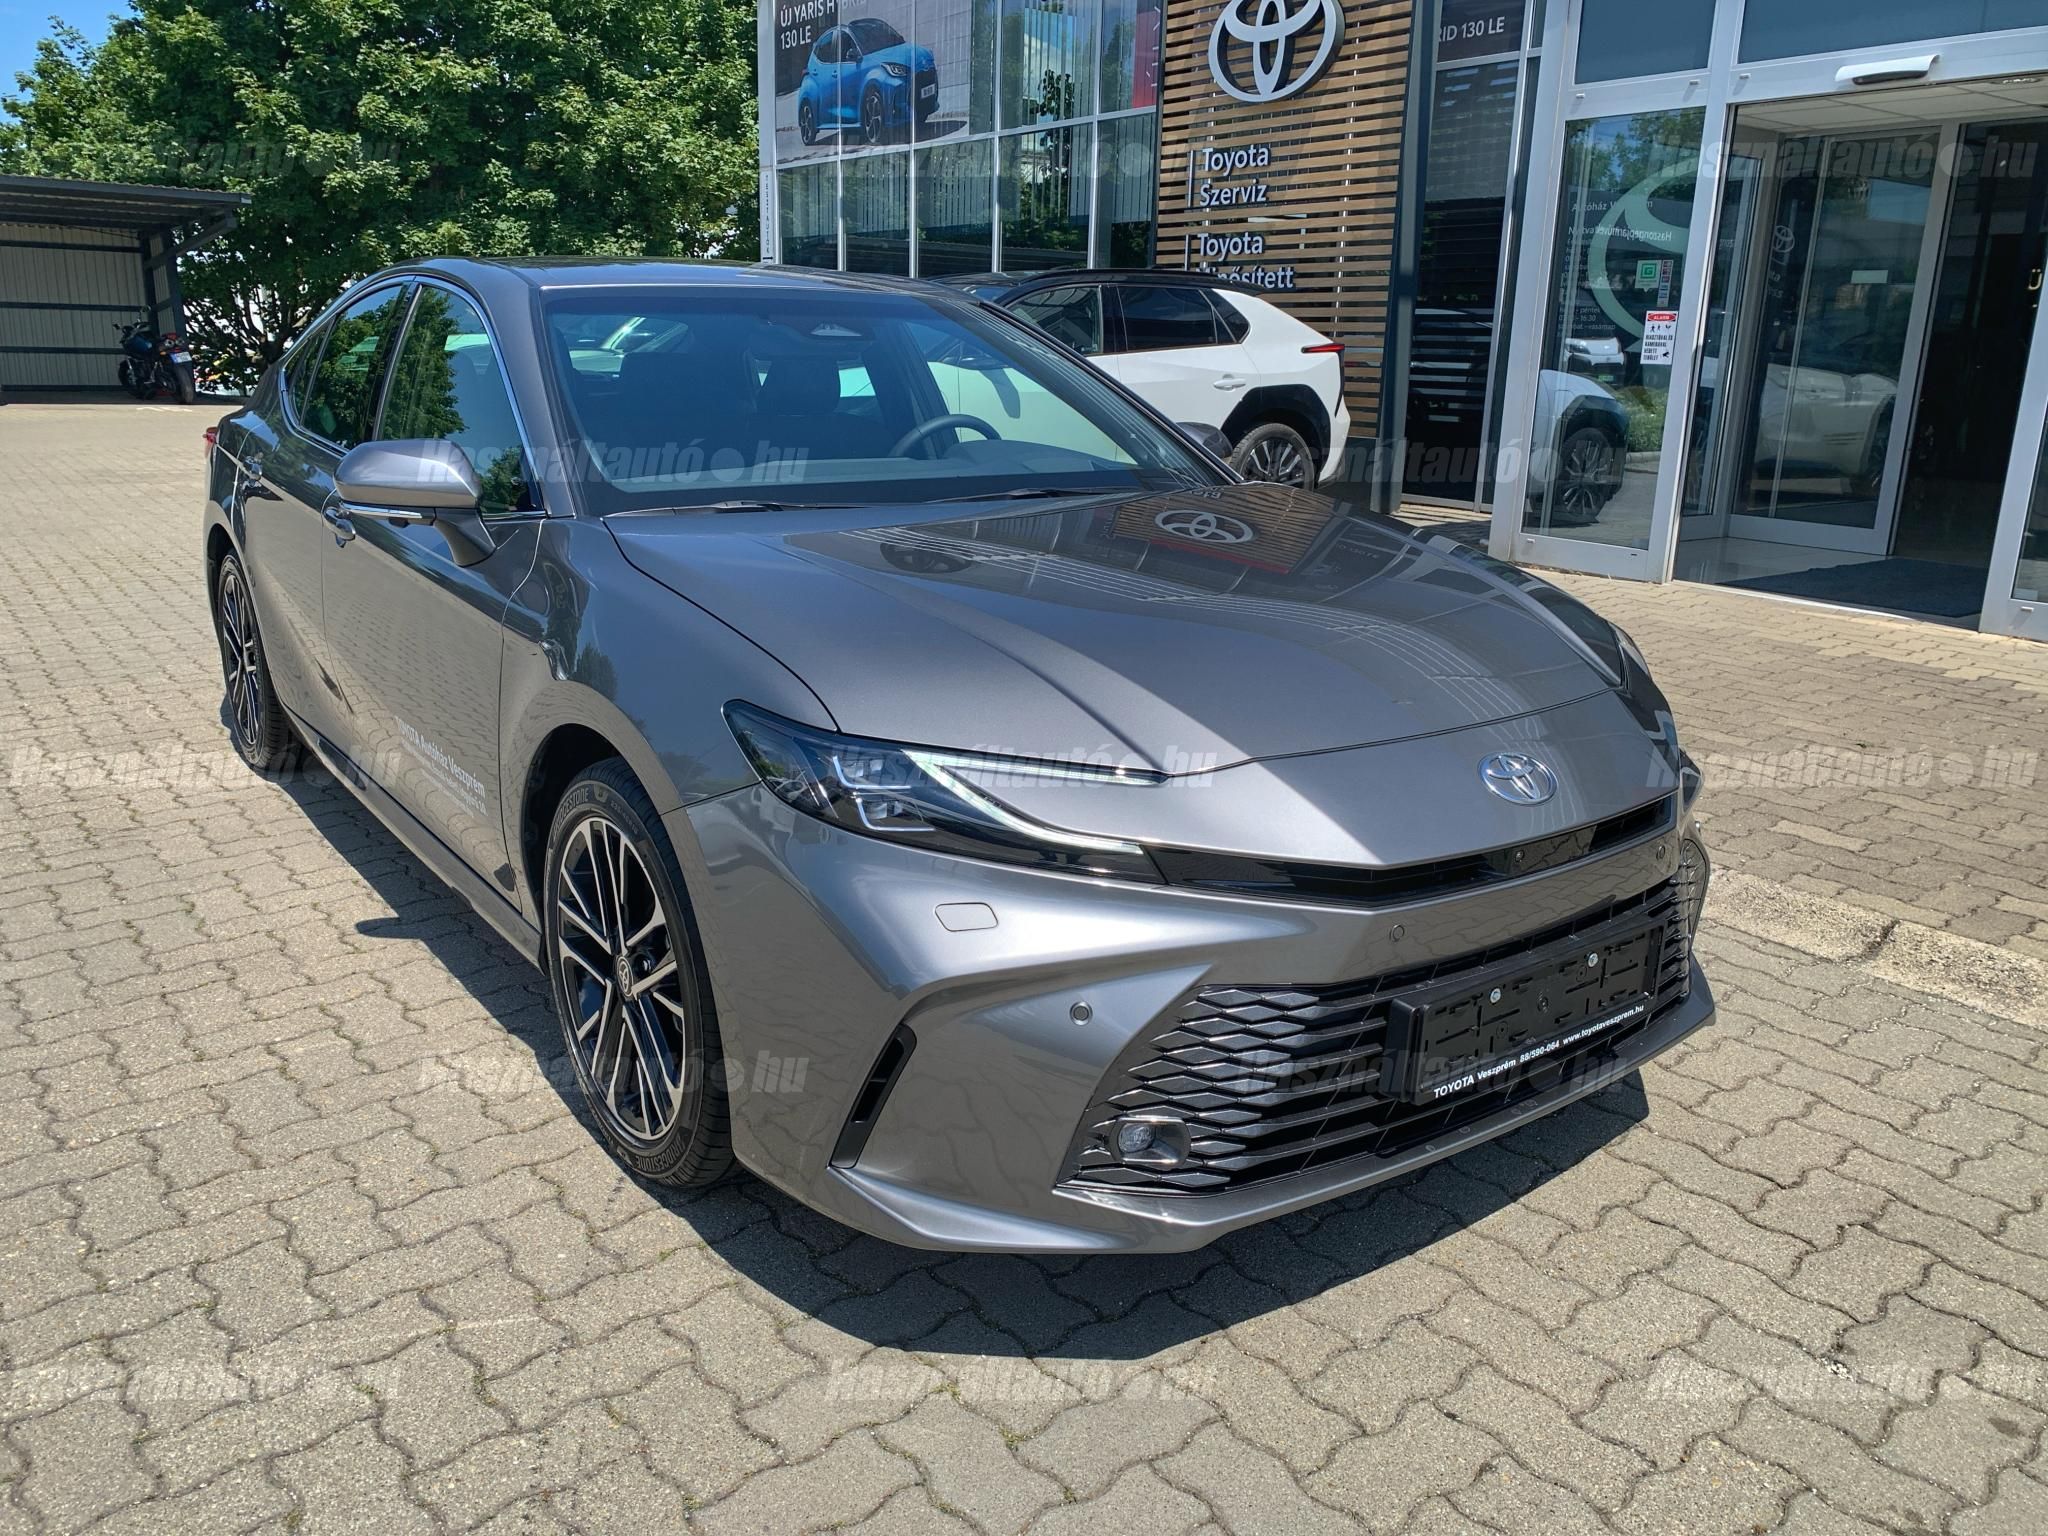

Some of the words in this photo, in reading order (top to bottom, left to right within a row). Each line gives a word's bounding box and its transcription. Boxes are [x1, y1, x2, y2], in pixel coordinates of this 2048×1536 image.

[780, 5, 792, 27] ÚJ
[794, 0, 824, 23] YARIS
[1461, 20, 1485, 39] 130
[1488, 16, 1505, 34] LE
[780, 30, 798, 50] 130
[799, 25, 812, 45] LE
[1201, 144, 1270, 176] Toyota
[1199, 178, 1268, 206] Szerviz
[1196, 231, 1263, 261] Toyota
[1195, 265, 1294, 289] ősített
[447, 754, 486, 799] Veszprém
[1433, 1075, 1475, 1099] TOYOTA
[1477, 1058, 1516, 1081] Veszprém
[1562, 1004, 1645, 1045] www.toyotaveszprem.hu
